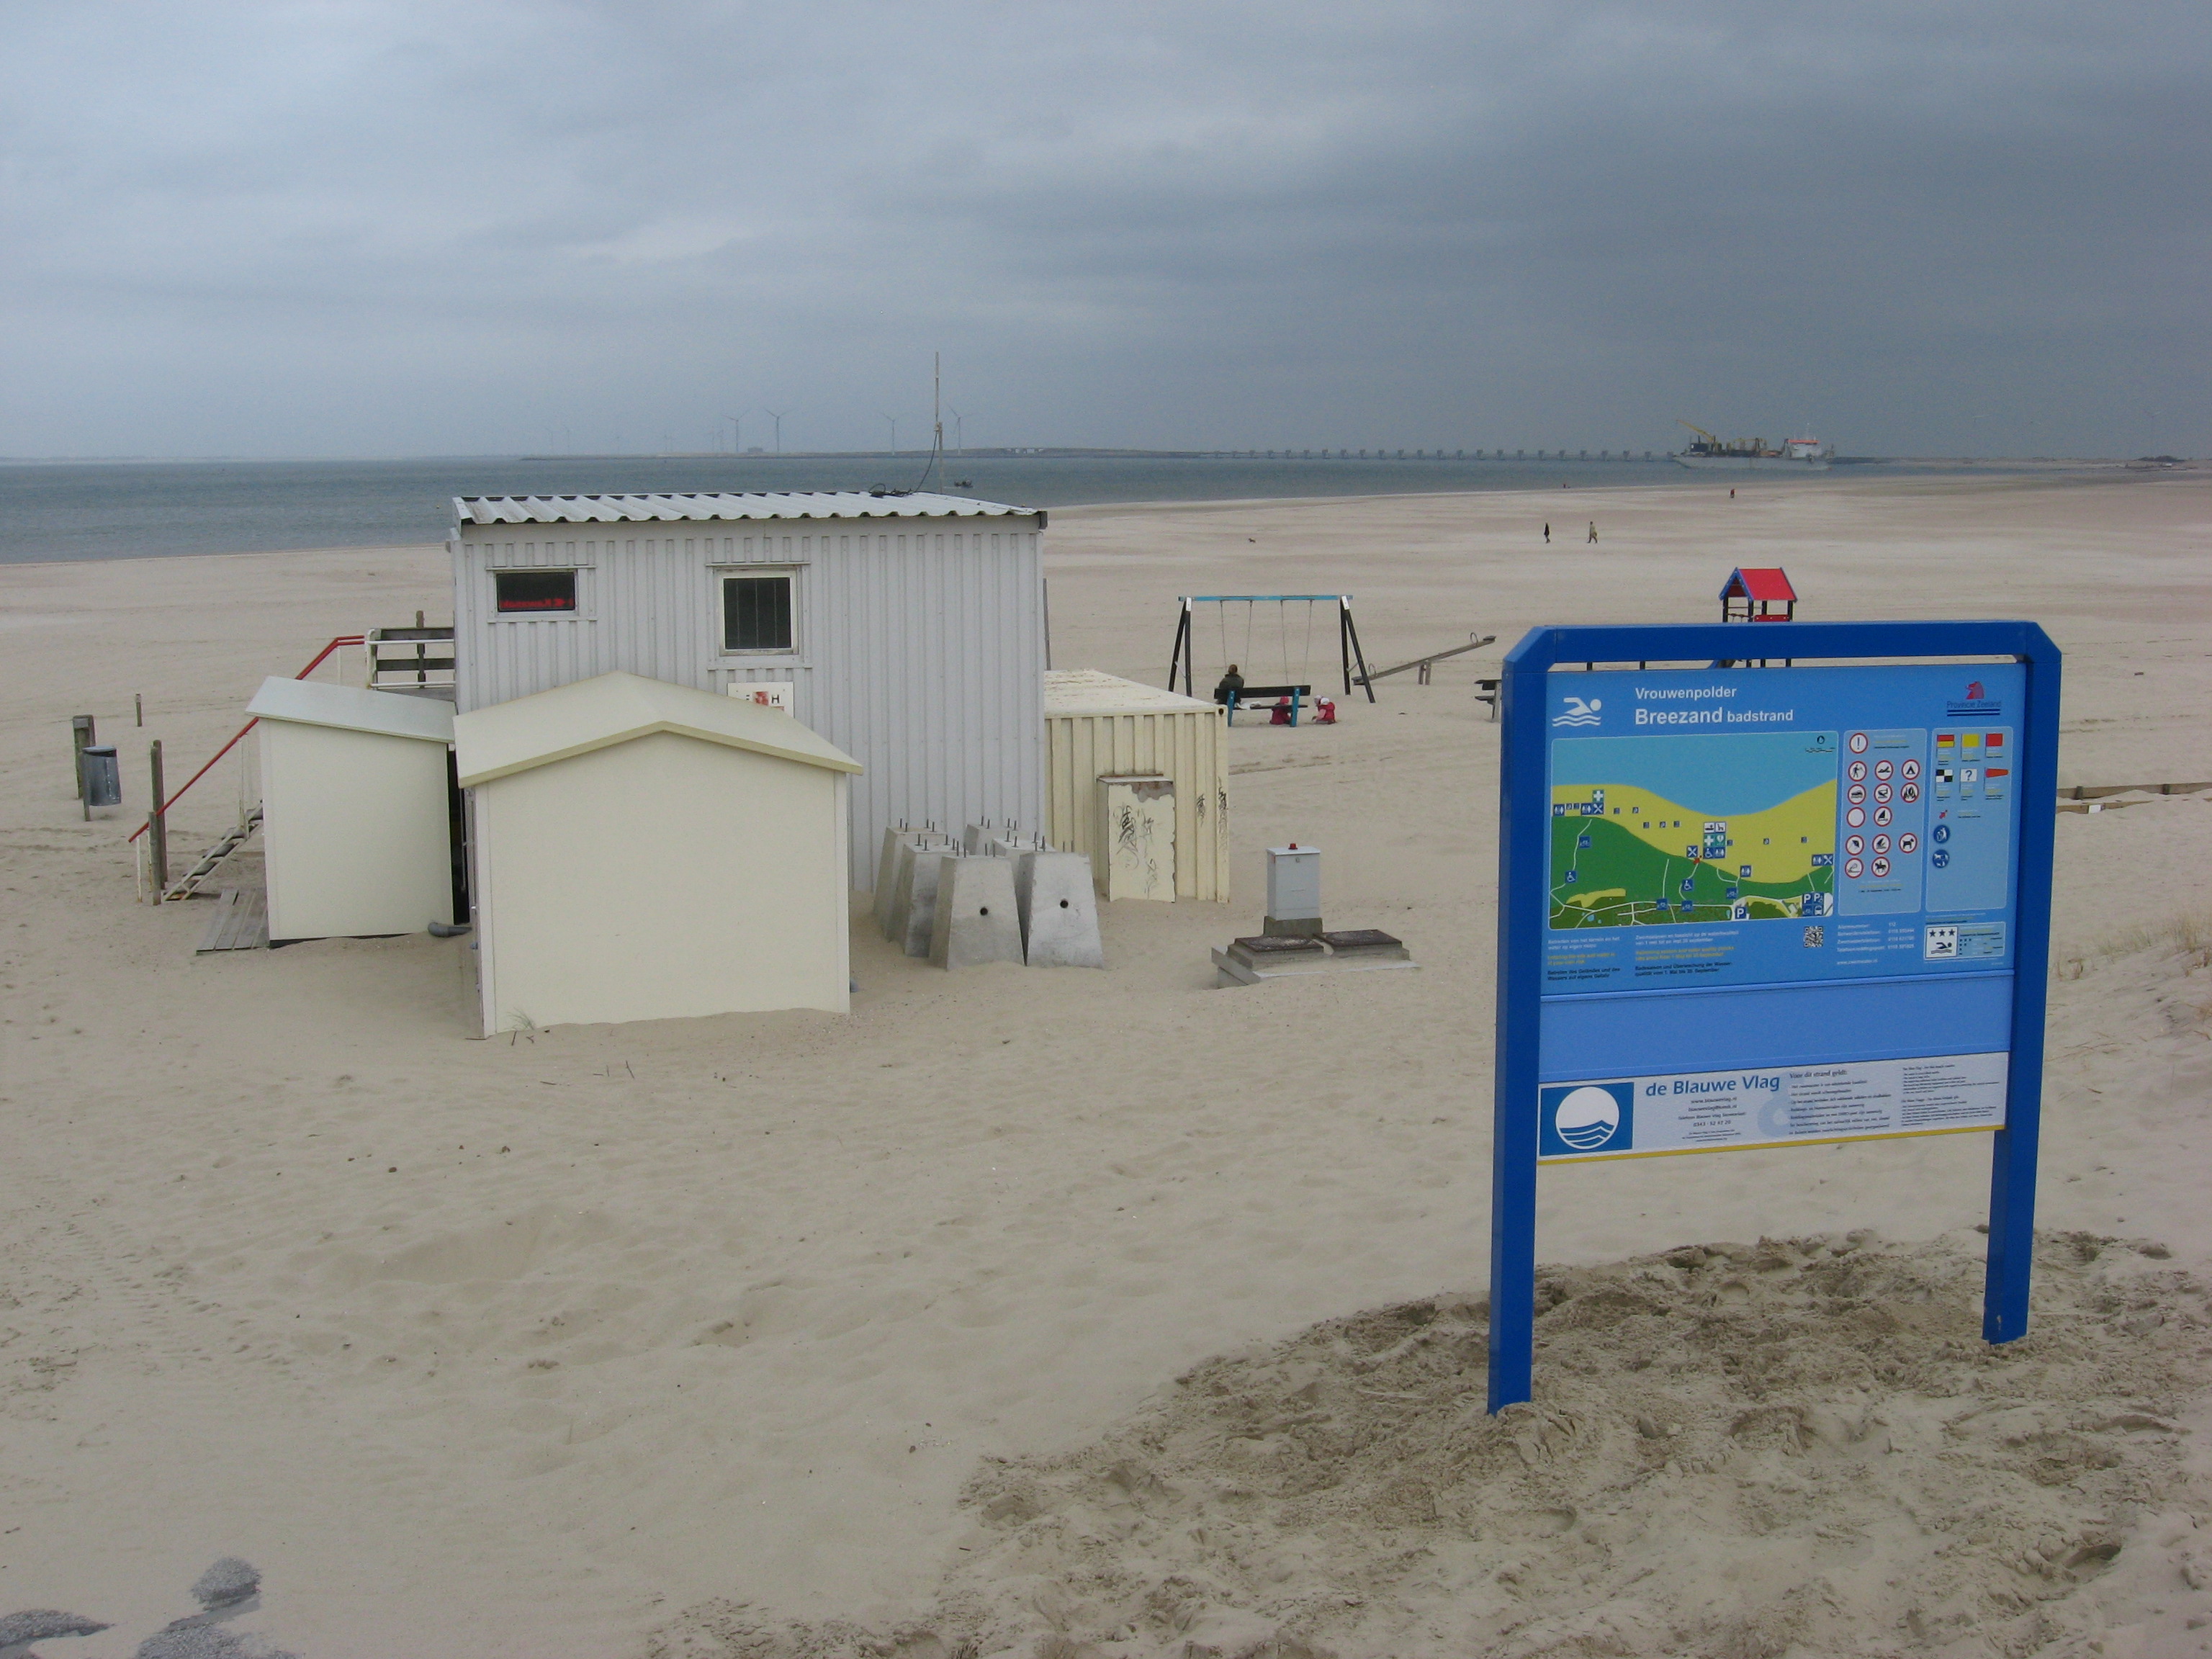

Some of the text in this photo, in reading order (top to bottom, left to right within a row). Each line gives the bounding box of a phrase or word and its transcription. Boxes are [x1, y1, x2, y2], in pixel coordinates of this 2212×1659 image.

[1635, 686, 1737, 701] Vrouwenpolder
[1635, 707, 1794, 725] Breezand badstrand
[1646, 1082, 1667, 1096] de
[1673, 1079, 1737, 1094] Blauwe
[1742, 1076, 1780, 1092] Vlag
